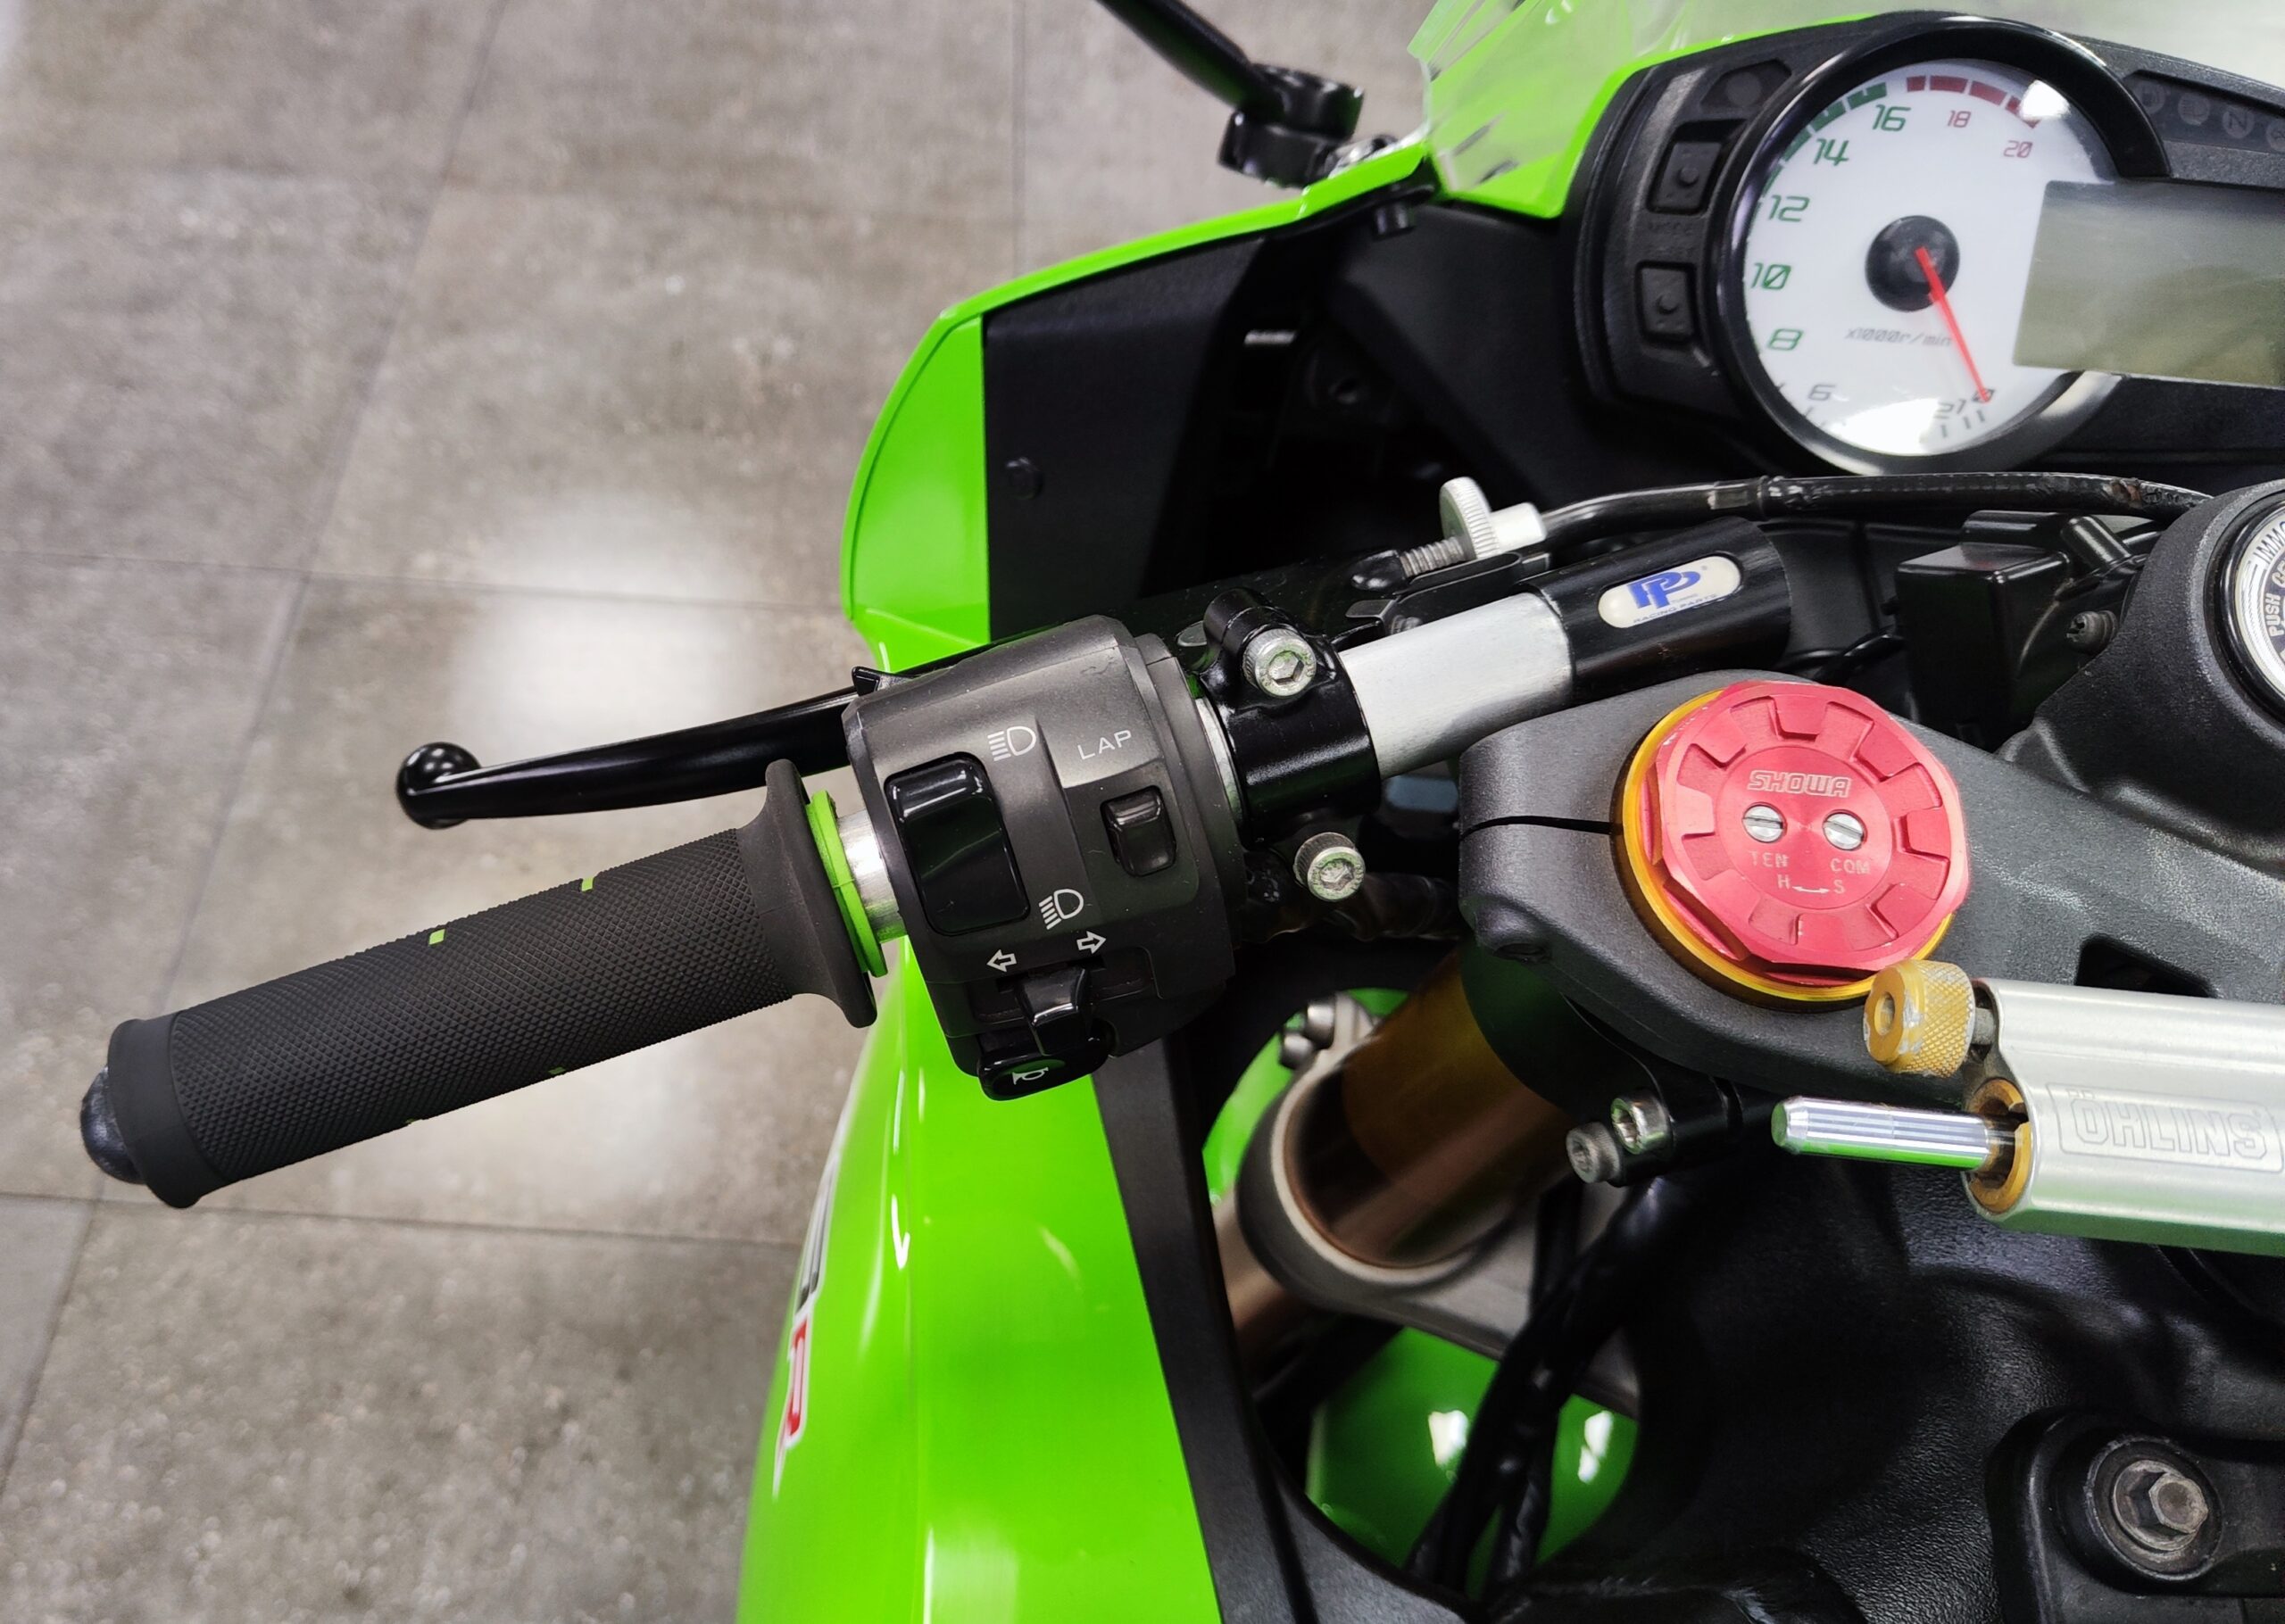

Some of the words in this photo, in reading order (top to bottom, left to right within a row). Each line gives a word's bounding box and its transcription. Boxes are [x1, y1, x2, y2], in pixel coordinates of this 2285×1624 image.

[1873, 104, 1911, 131] 16
[1947, 109, 1972, 128] 18
[1813, 138, 1849, 167] 14
[2003, 140, 2033, 159] 20
[1768, 195, 1810, 222] 12
[1750, 263, 1791, 290] 10
[1767, 328, 1804, 351] 8
[1807, 384, 1836, 401] 6
[2265, 592, 2285, 637] PUSH
[1077, 730, 1132, 760] LAP
[1747, 769, 1852, 798] SHOWA
[1749, 850, 1789, 868] TEN
[1831, 858, 1871, 875] COM
[1778, 874, 1791, 890] H
[1833, 879, 1846, 894] S
[2065, 1089, 2268, 1160] ÖHLINS
